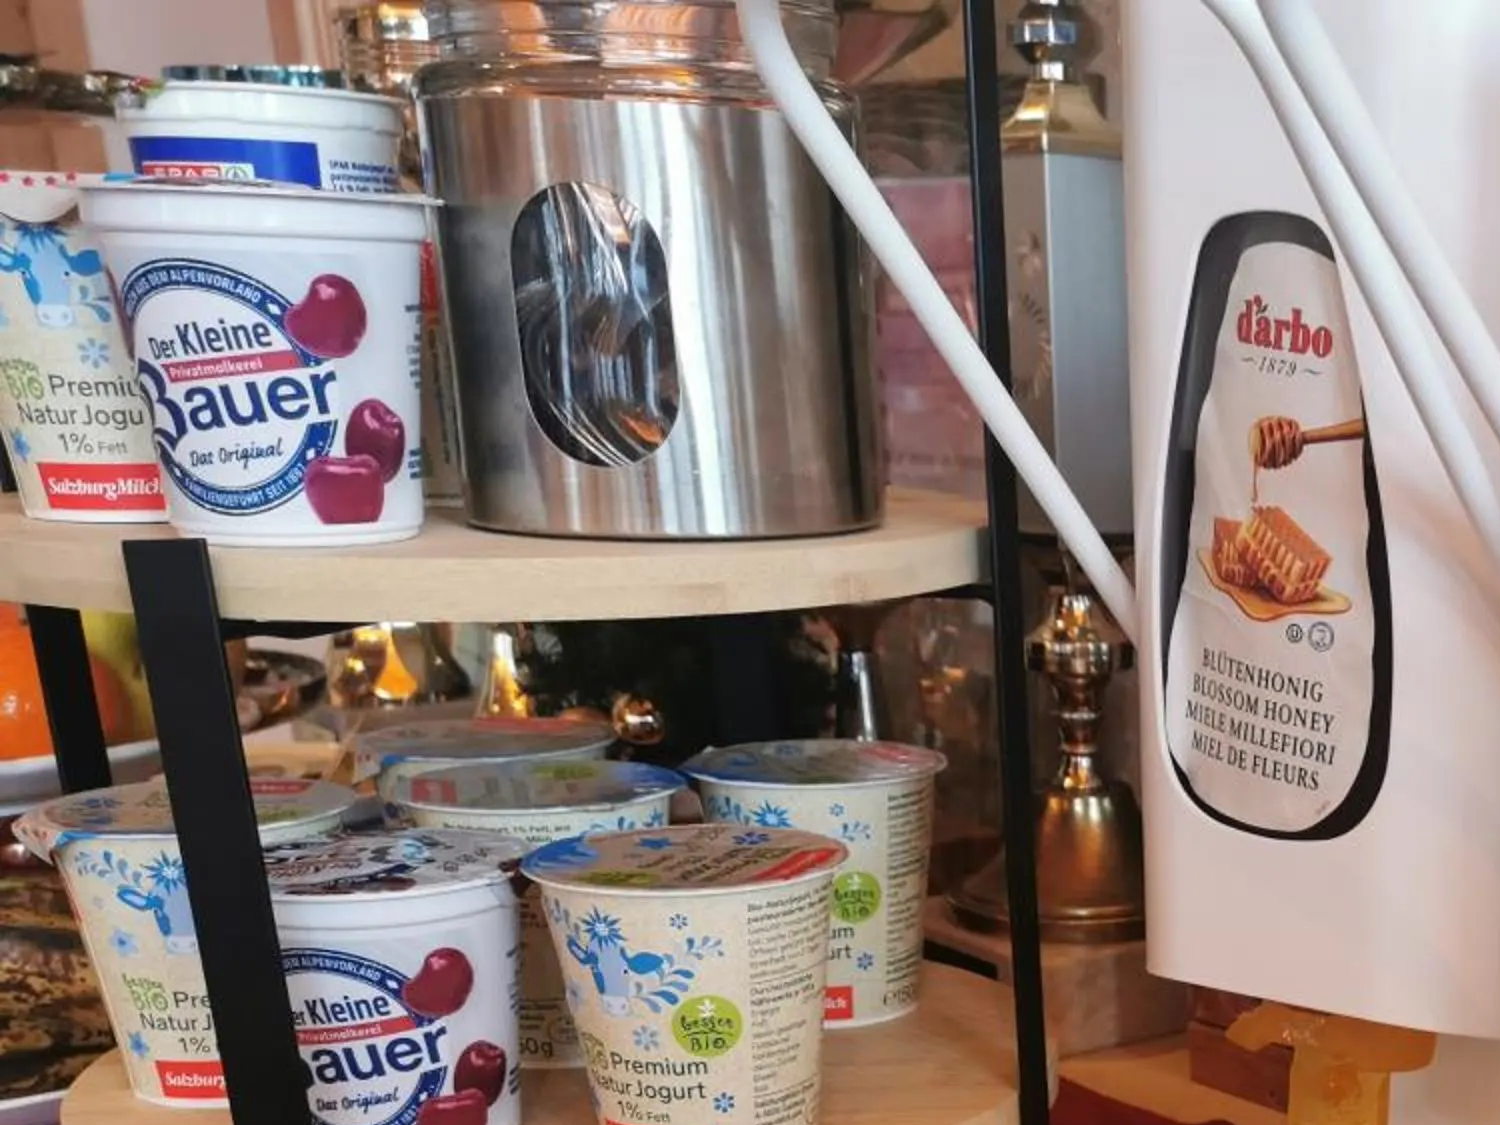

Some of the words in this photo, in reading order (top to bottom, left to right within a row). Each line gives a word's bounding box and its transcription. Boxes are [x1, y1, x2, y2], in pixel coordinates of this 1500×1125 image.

[169, 268, 262, 304] ALPENVORLAND
[148, 336, 177, 360] Der
[175, 318, 272, 356] Kleine
[169, 357, 263, 378] Privatmolkerei
[1259, 356, 1297, 377] 1879
[48, 374, 142, 397] Premiu
[17, 402, 77, 425] Natur
[83, 403, 144, 430] Jogu
[137, 358, 337, 451] Bauer
[58, 433, 94, 454] 1%
[99, 441, 128, 454] Fett
[190, 449, 215, 467] Das
[218, 438, 284, 469] Original
[265, 480, 287, 499] SEIT
[1202, 647, 1324, 703] BLÜTENHONIG
[1193, 673, 1258, 716] BLOSSOM
[1264, 699, 1335, 735] HONEY
[1185, 699, 1225, 734] MIELE
[1230, 717, 1336, 766] MILLEFIORI
[1192, 731, 1223, 761] MIEL
[1227, 746, 1248, 771] DE
[1252, 754, 1320, 791] FLEURS
[139, 1012, 199, 1032] Natur
[304, 995, 390, 1025] Kleine
[178, 1037, 211, 1054] 1%
[610, 1052, 708, 1077] Premium
[342, 1087, 400, 1113] Original
[636, 1081, 707, 1104] Jogurt
[618, 1100, 643, 1121] 1%
[646, 1111, 671, 1123] Fett
